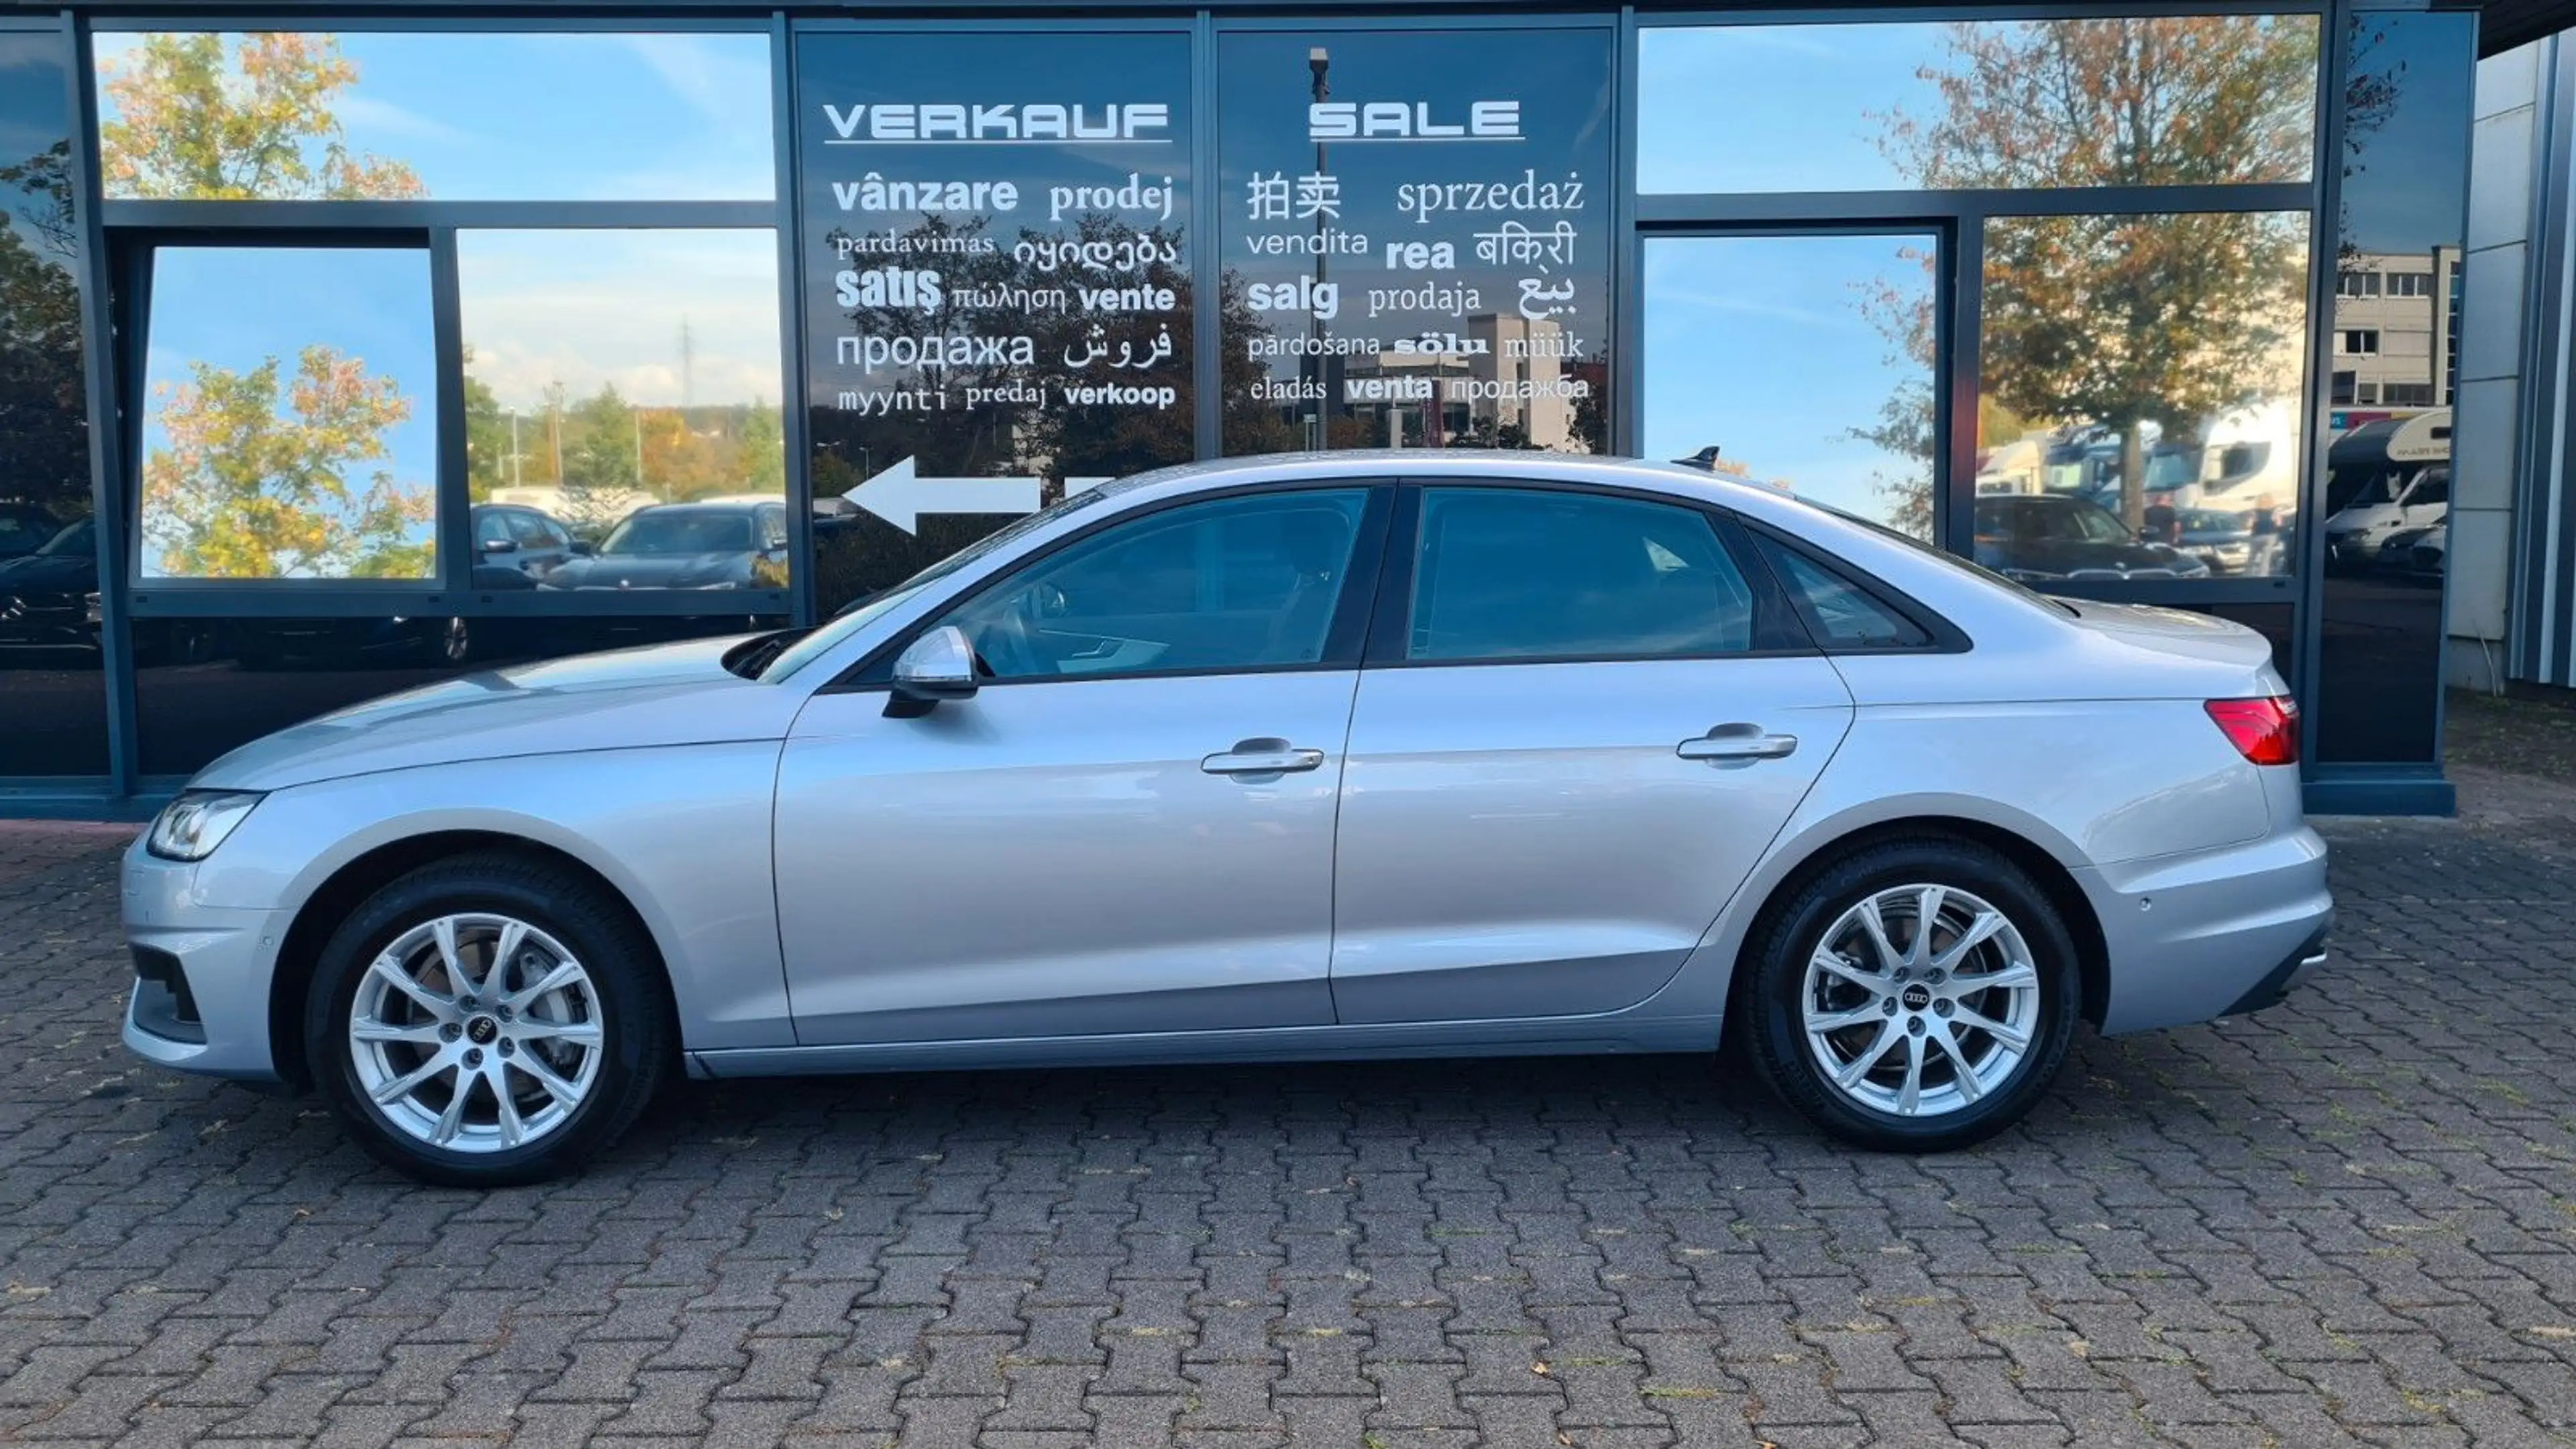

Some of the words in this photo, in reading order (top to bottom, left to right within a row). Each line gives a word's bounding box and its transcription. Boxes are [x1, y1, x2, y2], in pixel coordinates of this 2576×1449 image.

[822, 104, 1168, 138] VERKAUF
[1309, 101, 1519, 137] SALE
[832, 172, 1018, 211] vânzare
[1050, 174, 1173, 221] prodej
[1246, 171, 1341, 220] 拍卖
[1397, 169, 1584, 223] sprzedaż
[837, 229, 994, 260] pardavimas
[1014, 233, 1177, 272] იყიდება
[1246, 229, 1368, 254] vendita
[1386, 239, 1455, 270] rea
[836, 266, 941, 315] satış
[954, 283, 1066, 315] πώληση
[1079, 284, 1175, 310] vente
[1248, 276, 1338, 319] salg
[1368, 282, 1481, 318] prodaja
[837, 335, 1034, 374] продажа
[1248, 333, 1380, 360] pārdošana
[1394, 333, 1489, 355] sölu
[1505, 331, 1583, 358] müük
[839, 383, 947, 415] myynti
[965, 380, 1047, 410] predaj
[1064, 383, 1175, 411] verkoop
[1251, 377, 1327, 400] eladás
[1348, 374, 1432, 399] venta
[1452, 374, 1589, 407] продажба
